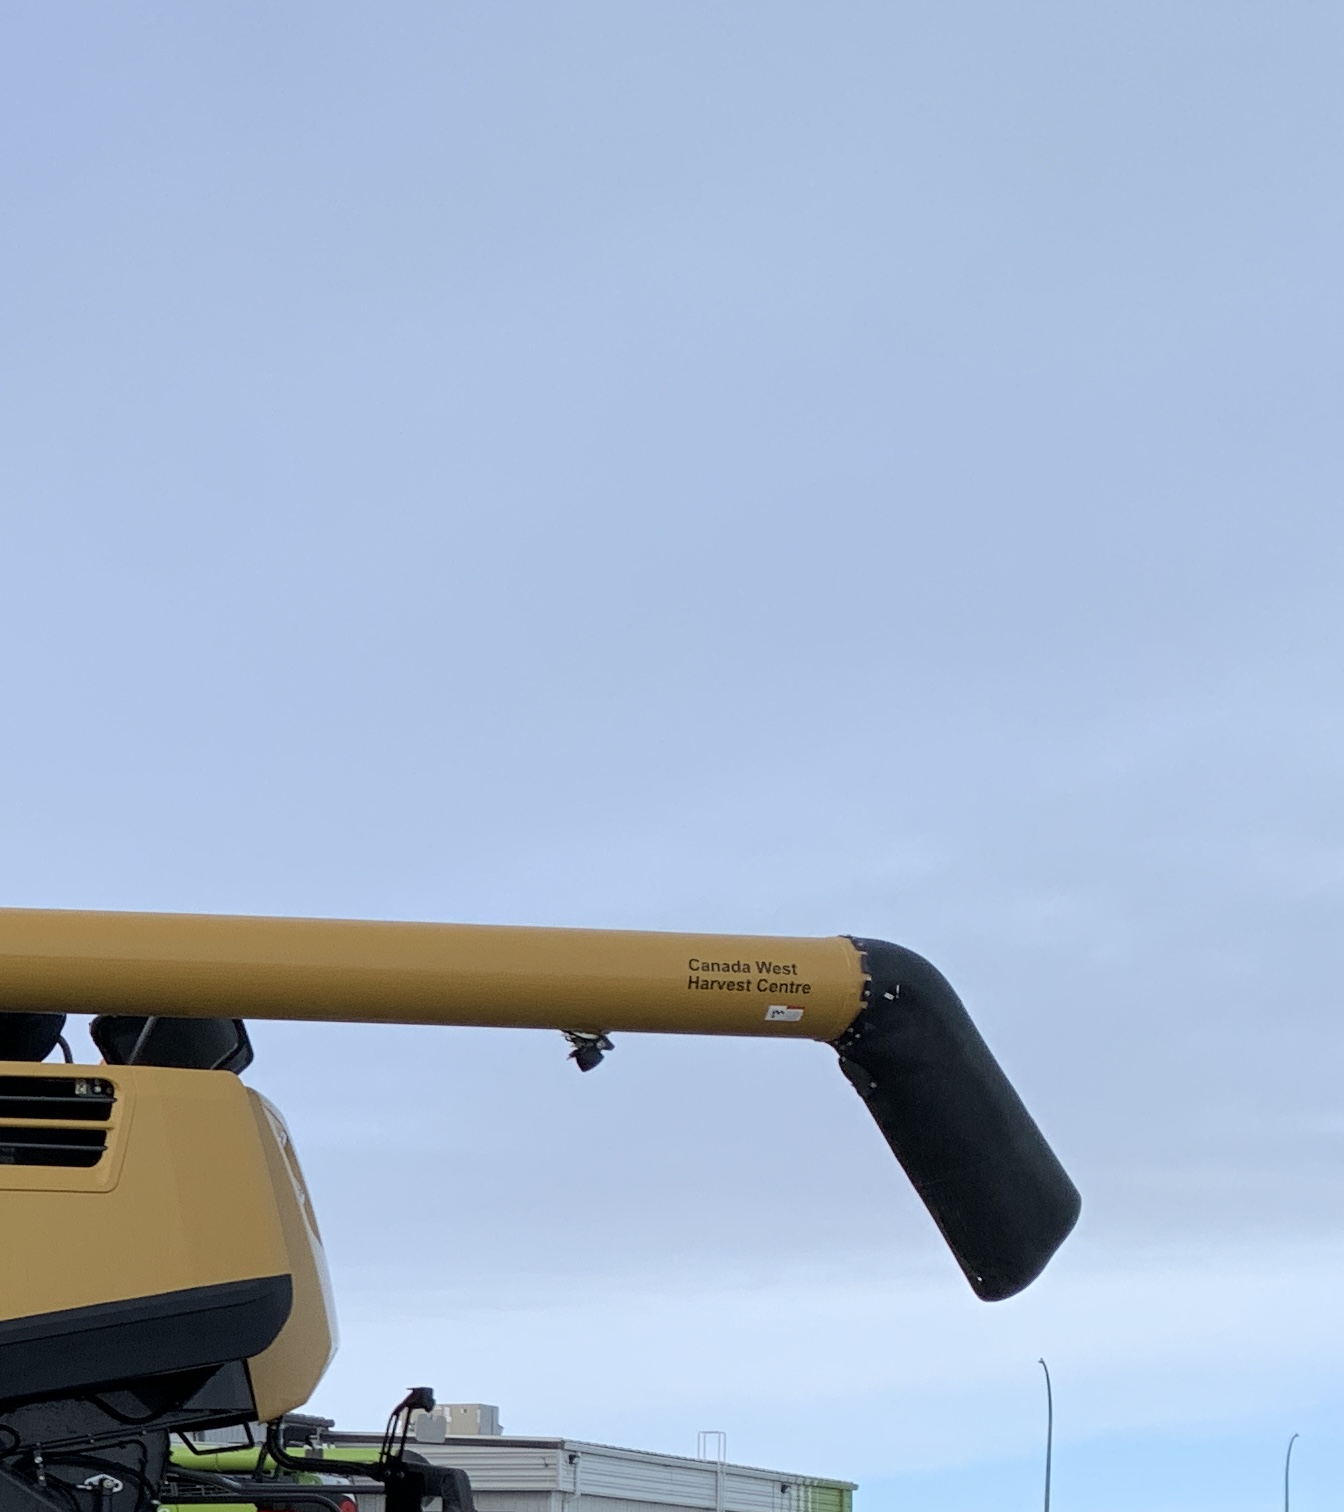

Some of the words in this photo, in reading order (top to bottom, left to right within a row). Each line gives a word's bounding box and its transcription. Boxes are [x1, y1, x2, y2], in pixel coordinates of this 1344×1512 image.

[688, 958, 751, 974] Canada
[755, 960, 798, 976] West
[687, 975, 752, 992] Harvest
[757, 979, 811, 994] Centre
